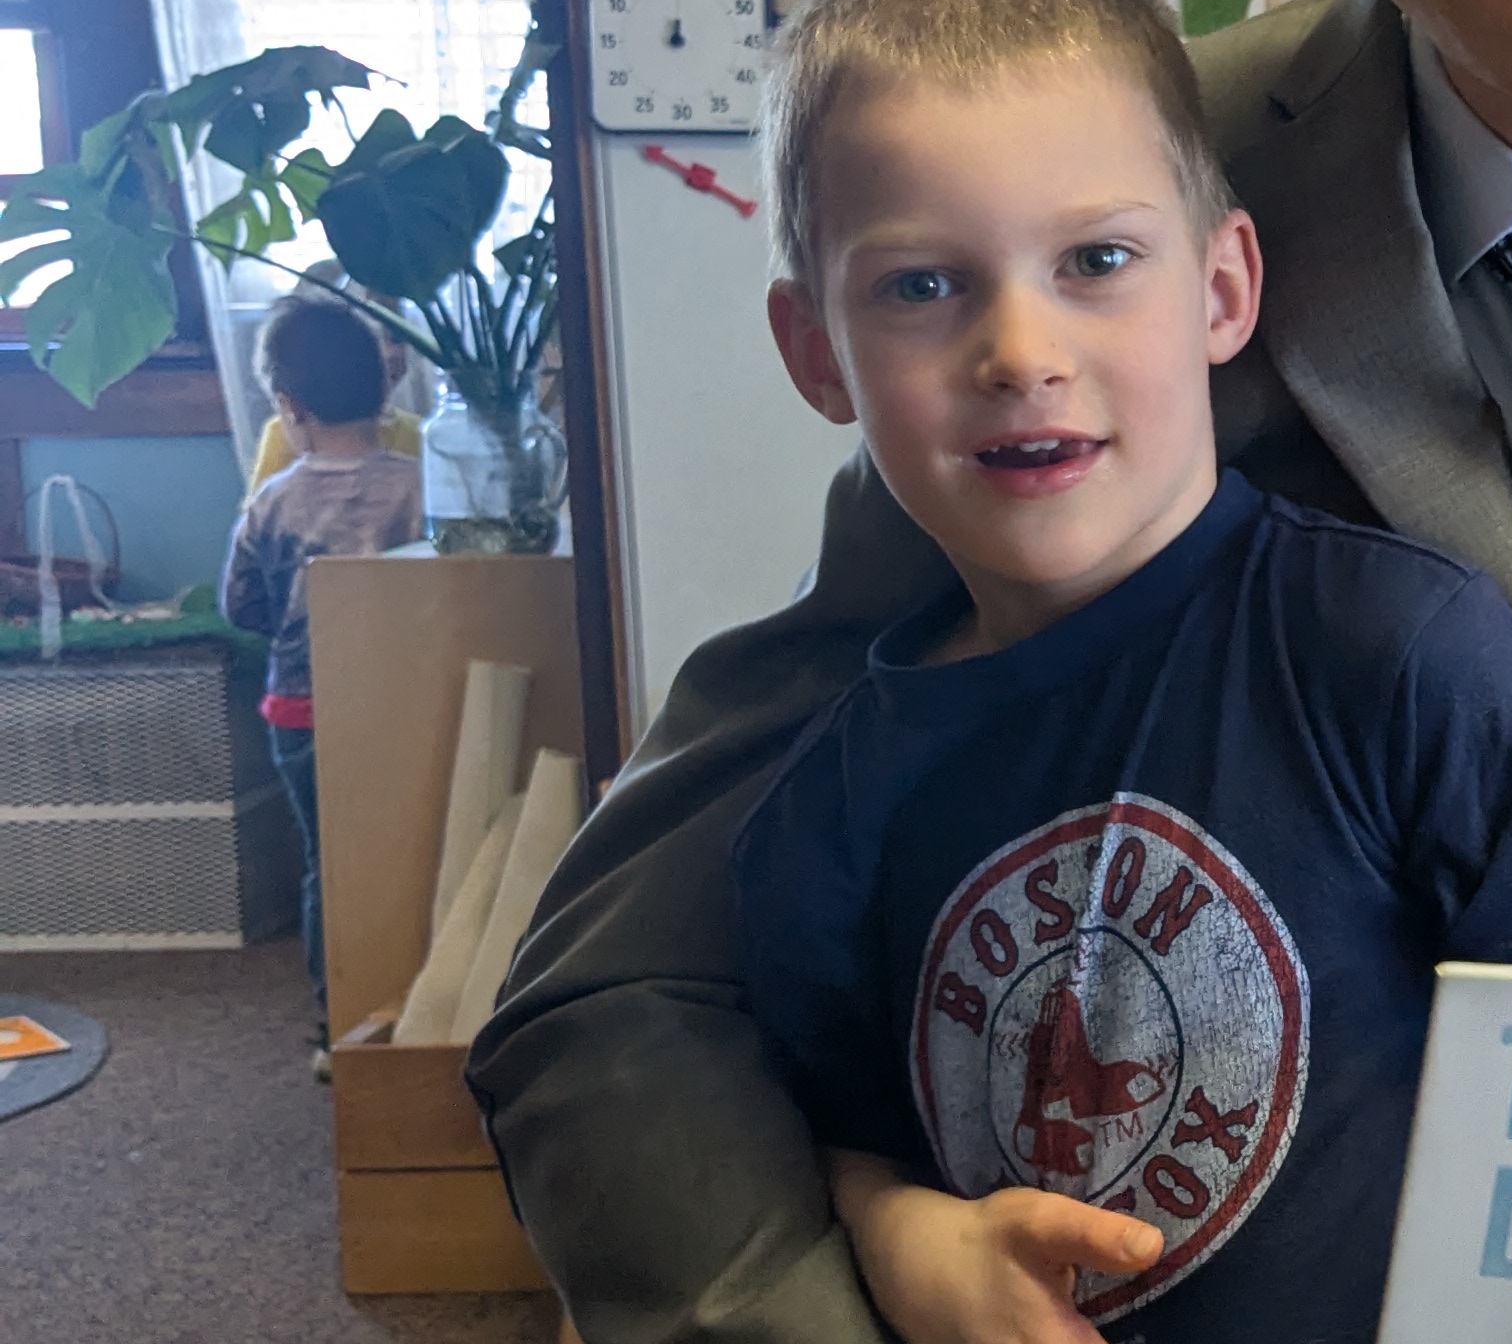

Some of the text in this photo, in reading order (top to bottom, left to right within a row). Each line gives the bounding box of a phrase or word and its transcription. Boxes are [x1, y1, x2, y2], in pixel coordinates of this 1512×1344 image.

[735, 0, 755, 15] 50
[601, 33, 617, 49] 15
[609, 70, 629, 87] 20
[736, 69, 756, 85] 40
[635, 96, 655, 114] 25
[672, 103, 693, 121] 30
[710, 96, 730, 114] 35
[935, 836, 1213, 1037] BOSON
[1099, 1111, 1145, 1150] TM
[1100, 1085, 1260, 1220] OX
